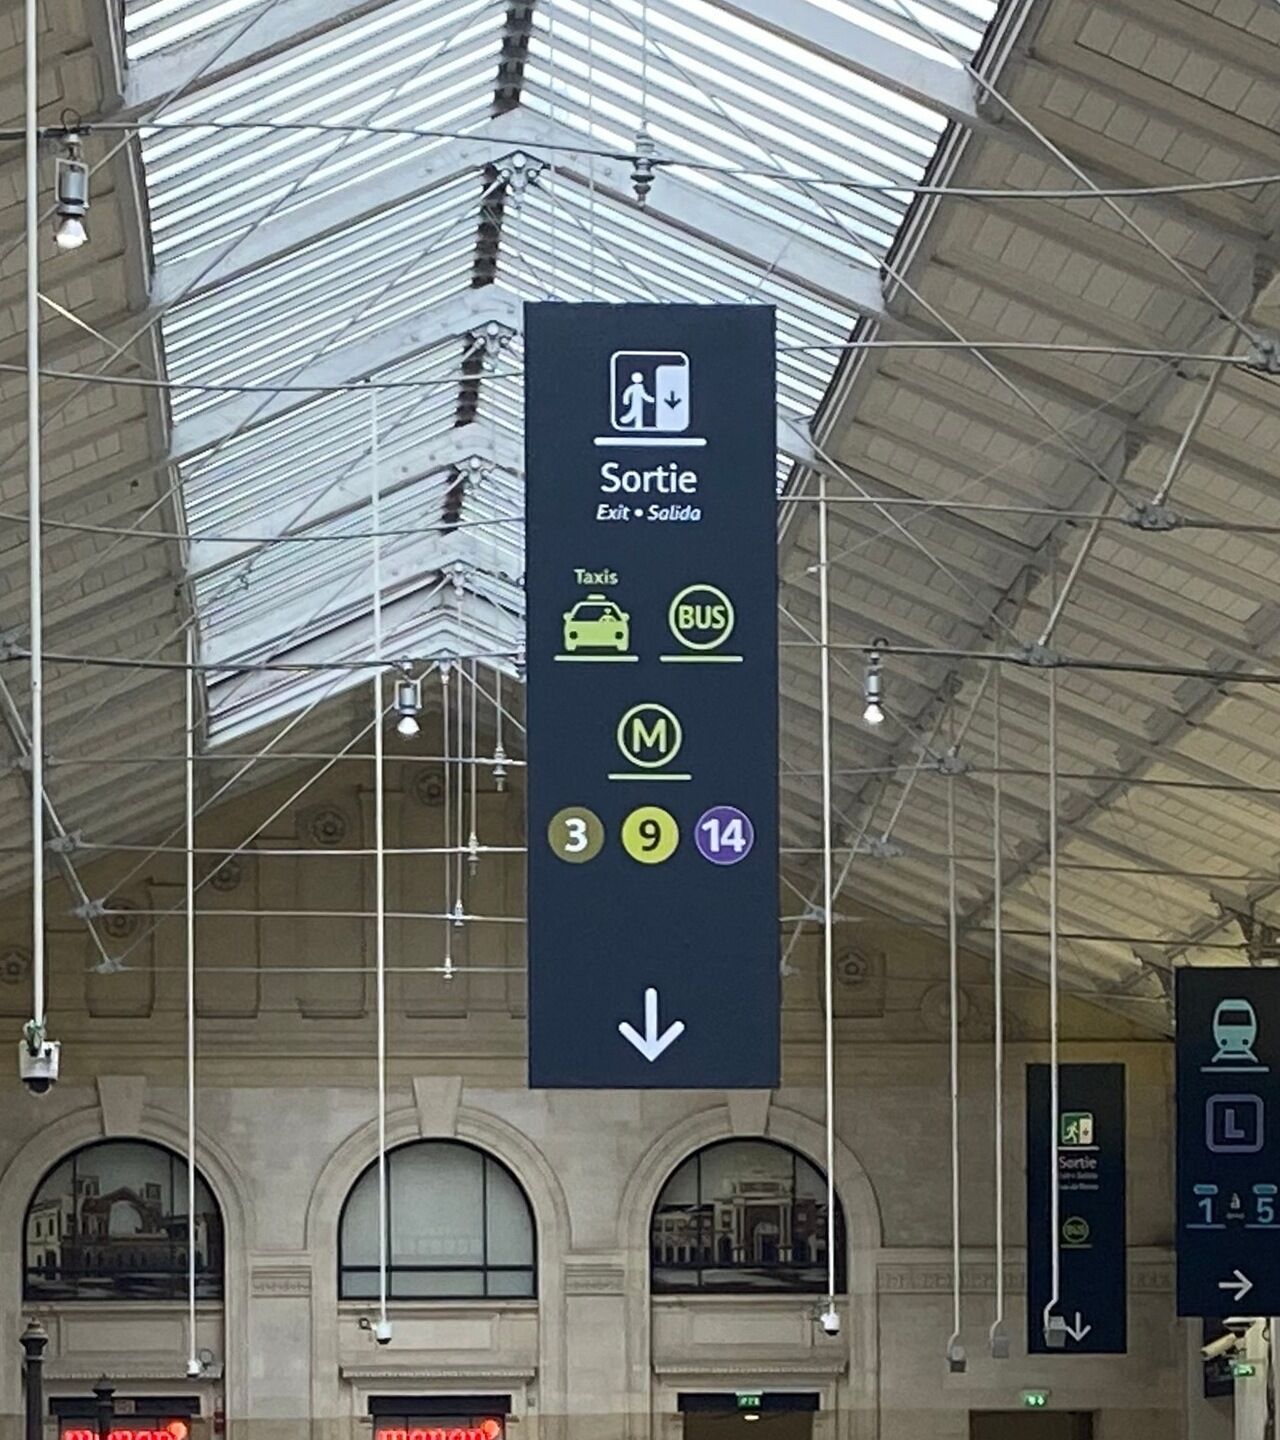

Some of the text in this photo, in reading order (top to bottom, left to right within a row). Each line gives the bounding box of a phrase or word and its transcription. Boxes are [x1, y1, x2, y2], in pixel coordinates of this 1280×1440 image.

[600, 462, 698, 493] Sortie
[596, 504, 701, 521] Exit Salida
[574, 568, 618, 585] Taxis
[678, 605, 726, 629] BUS
[633, 718, 667, 753] M
[564, 818, 746, 852] 3 9 14
[1225, 1109, 1245, 1138] L
[1198, 1198, 1212, 1223] 1
[1257, 1197, 1274, 1223] 5
